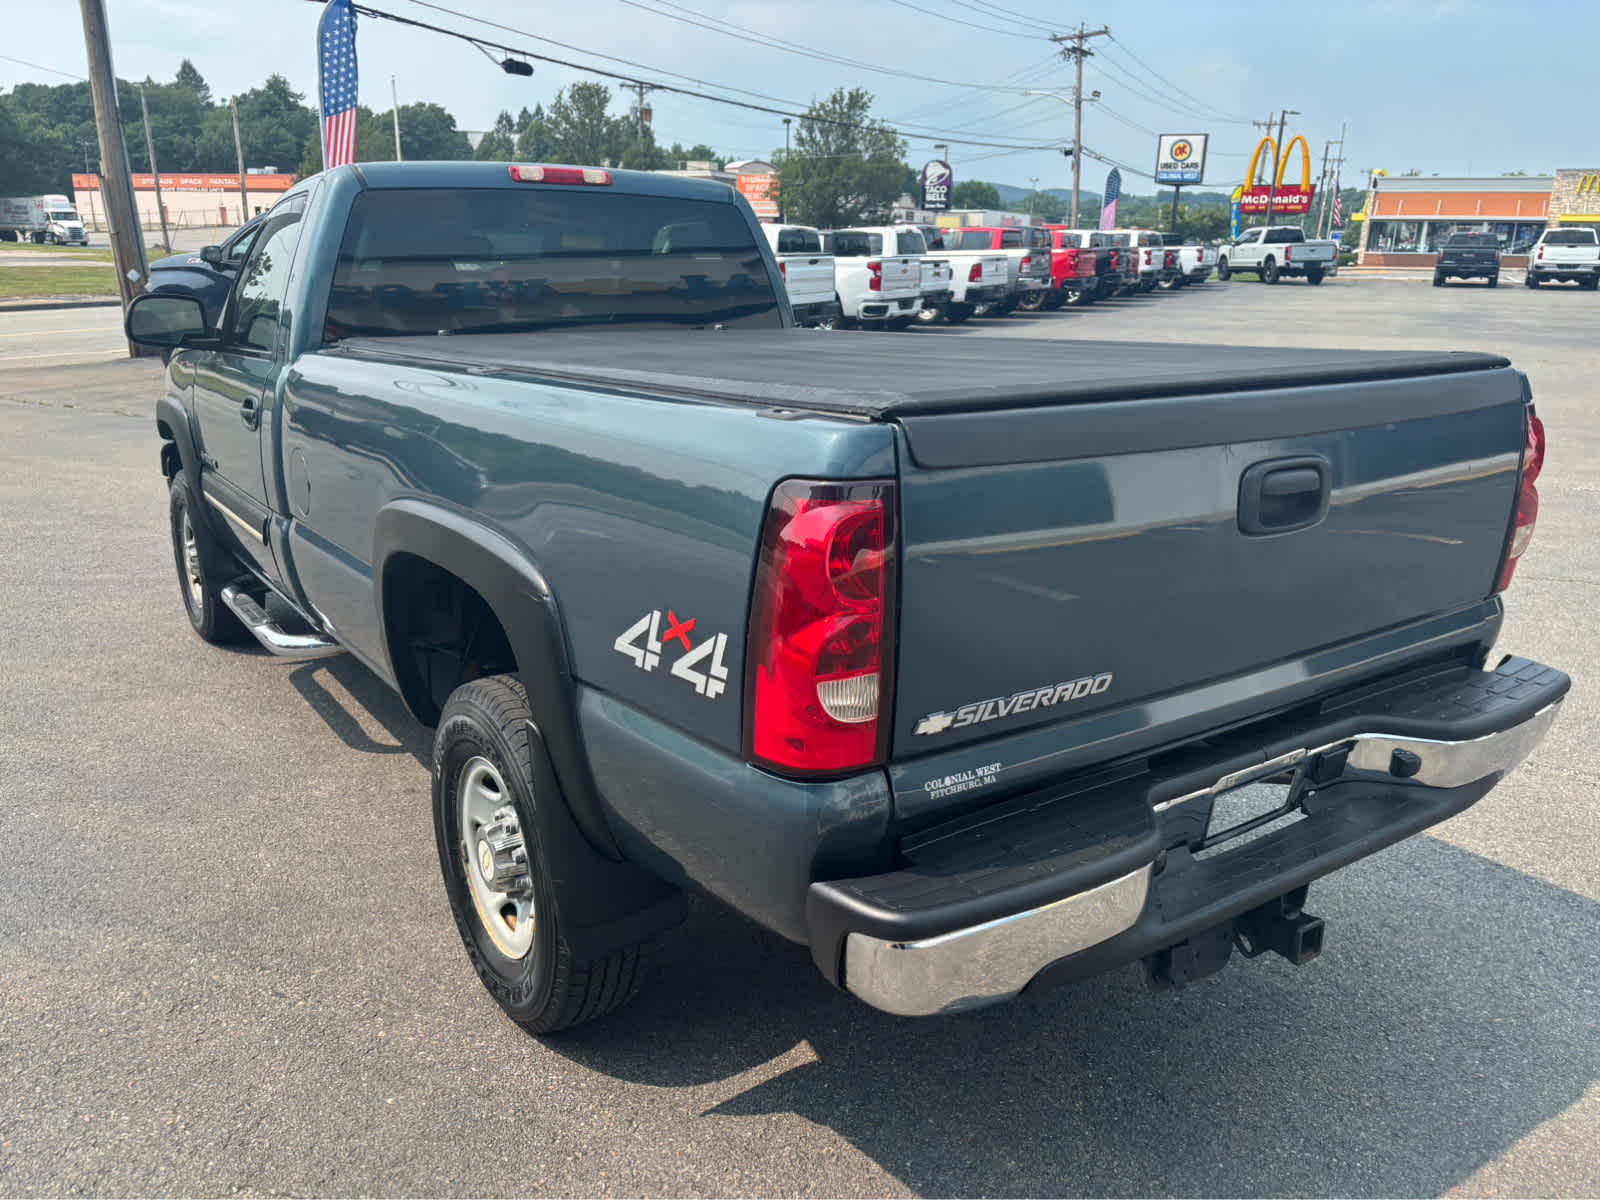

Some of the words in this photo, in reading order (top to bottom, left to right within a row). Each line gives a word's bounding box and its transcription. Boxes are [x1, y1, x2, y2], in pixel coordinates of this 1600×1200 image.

[925, 185, 947, 193] TACO
[925, 192, 947, 201] BELL
[953, 672, 1112, 728] SILVERADO
[924, 770, 975, 791] COLONIAL
[975, 763, 1001, 777] WEST
[983, 774, 997, 785] MA
